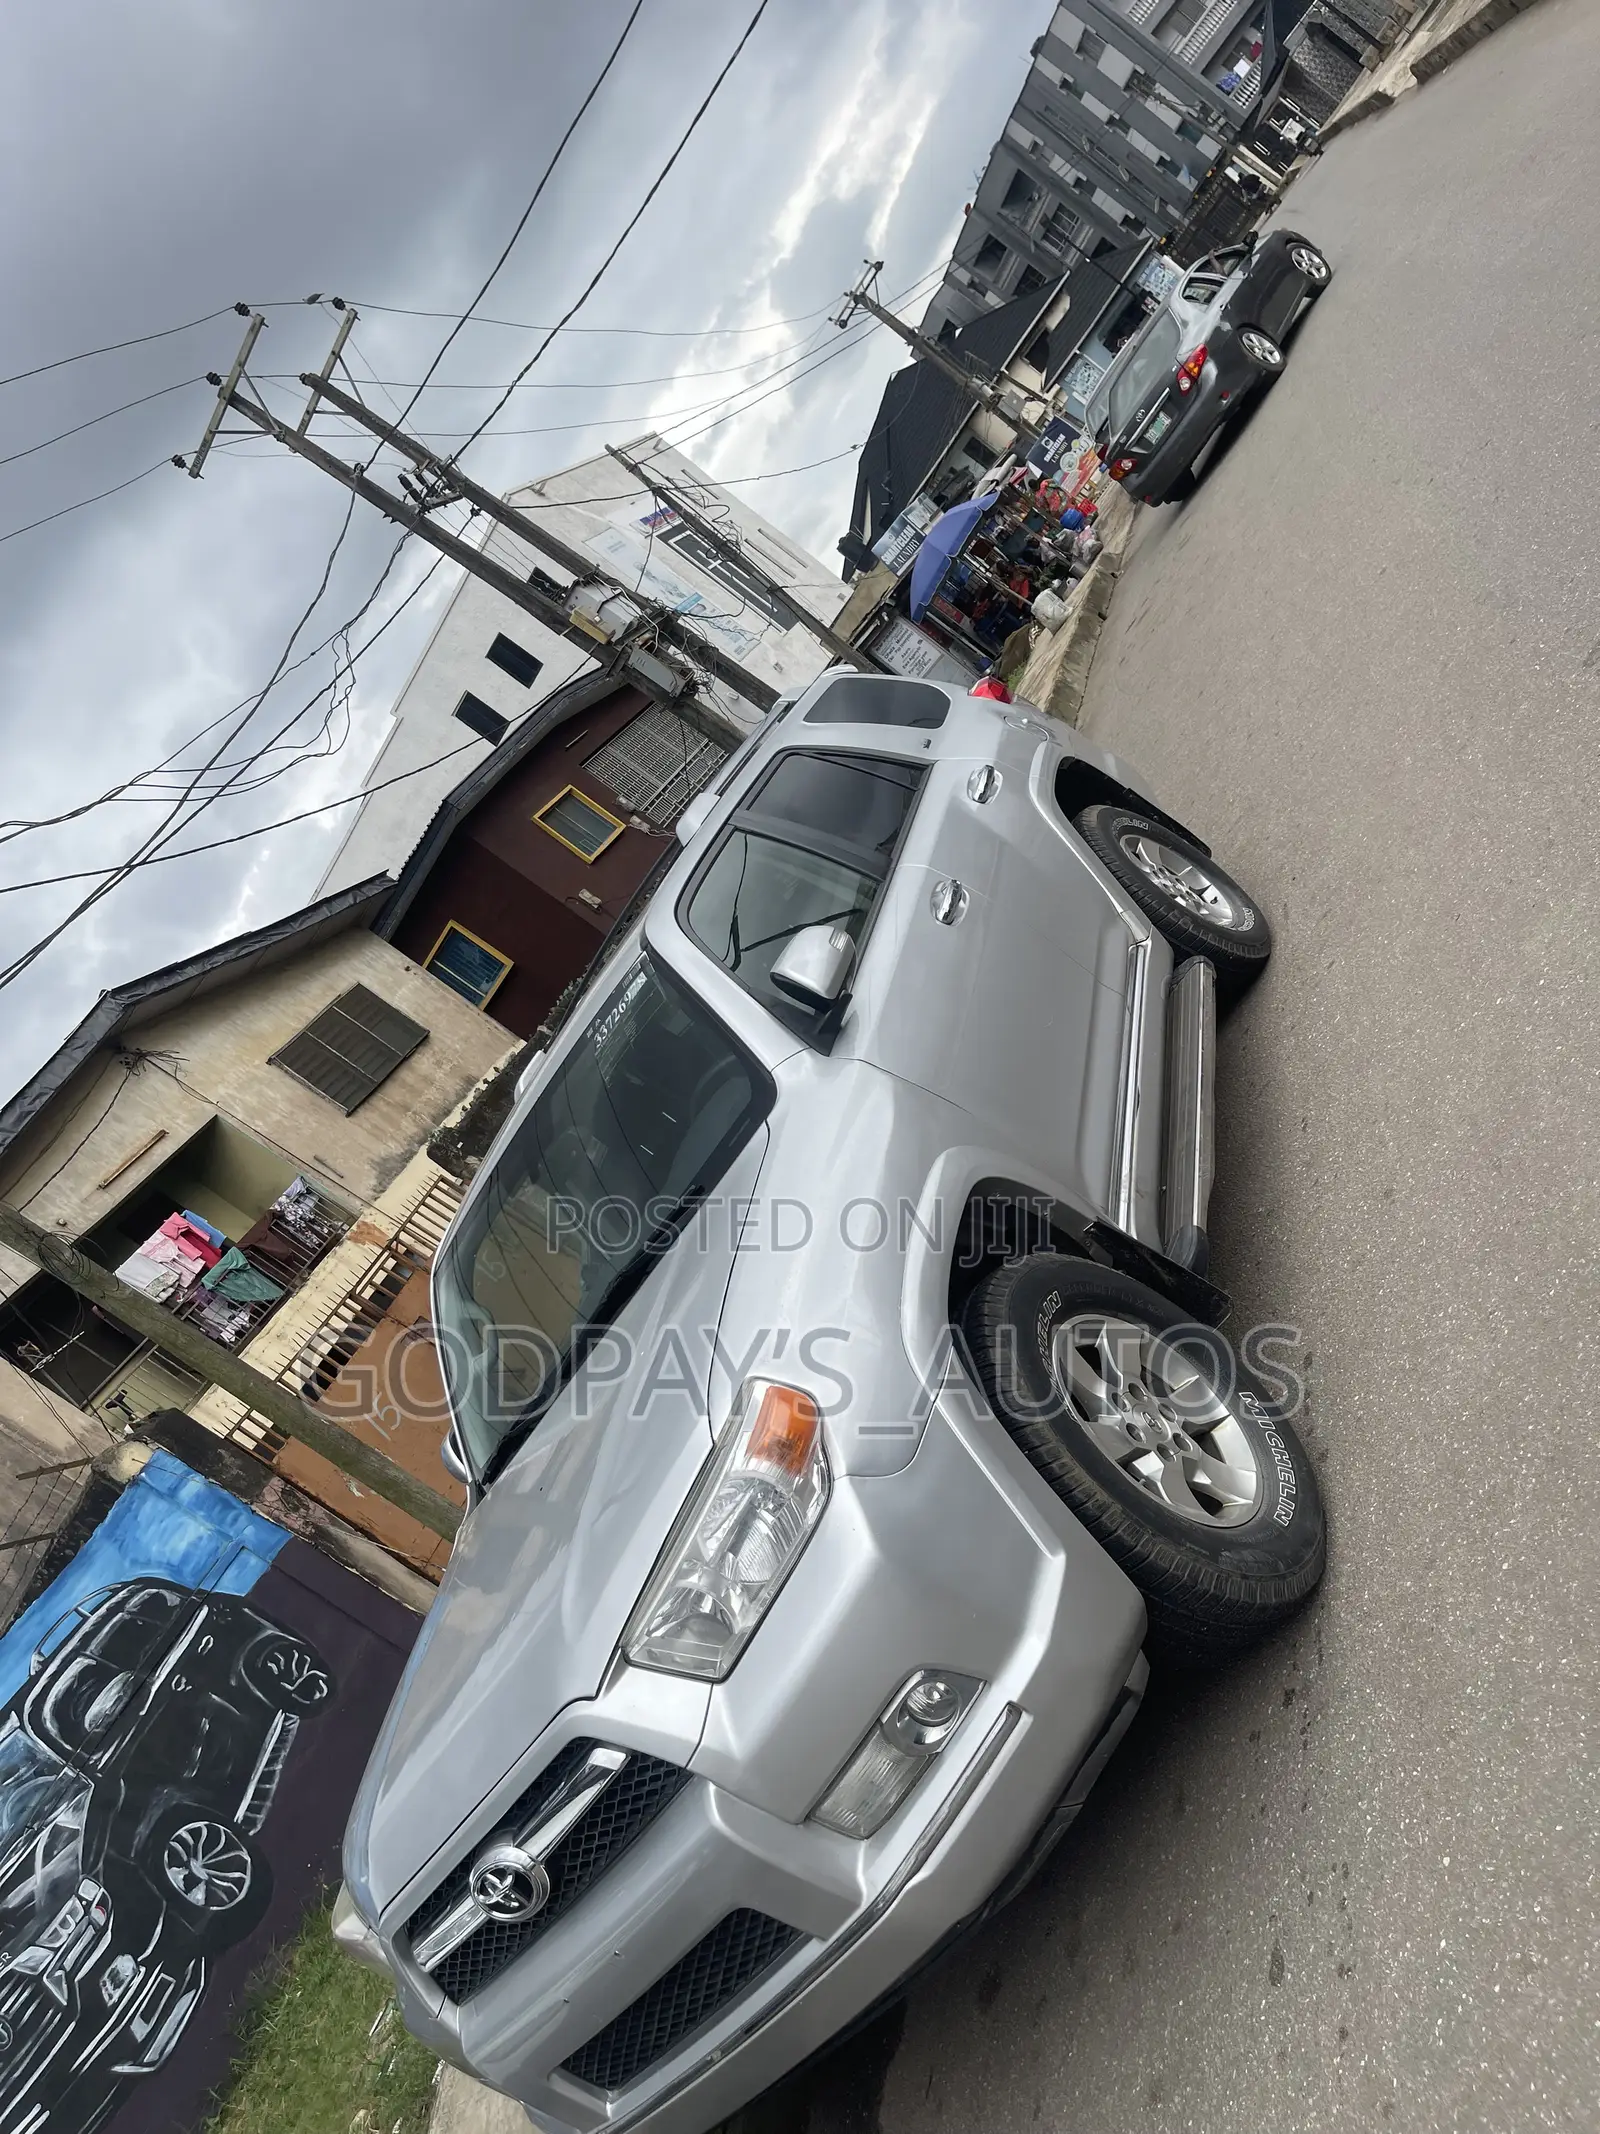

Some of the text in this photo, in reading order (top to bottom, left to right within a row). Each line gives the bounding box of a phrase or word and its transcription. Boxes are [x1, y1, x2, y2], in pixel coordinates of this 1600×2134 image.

[881, 524, 916, 565] SMARTCLEAN
[892, 538, 920, 568] LAUNDRY
[1239, 1391, 1296, 1527] MICHELIN
